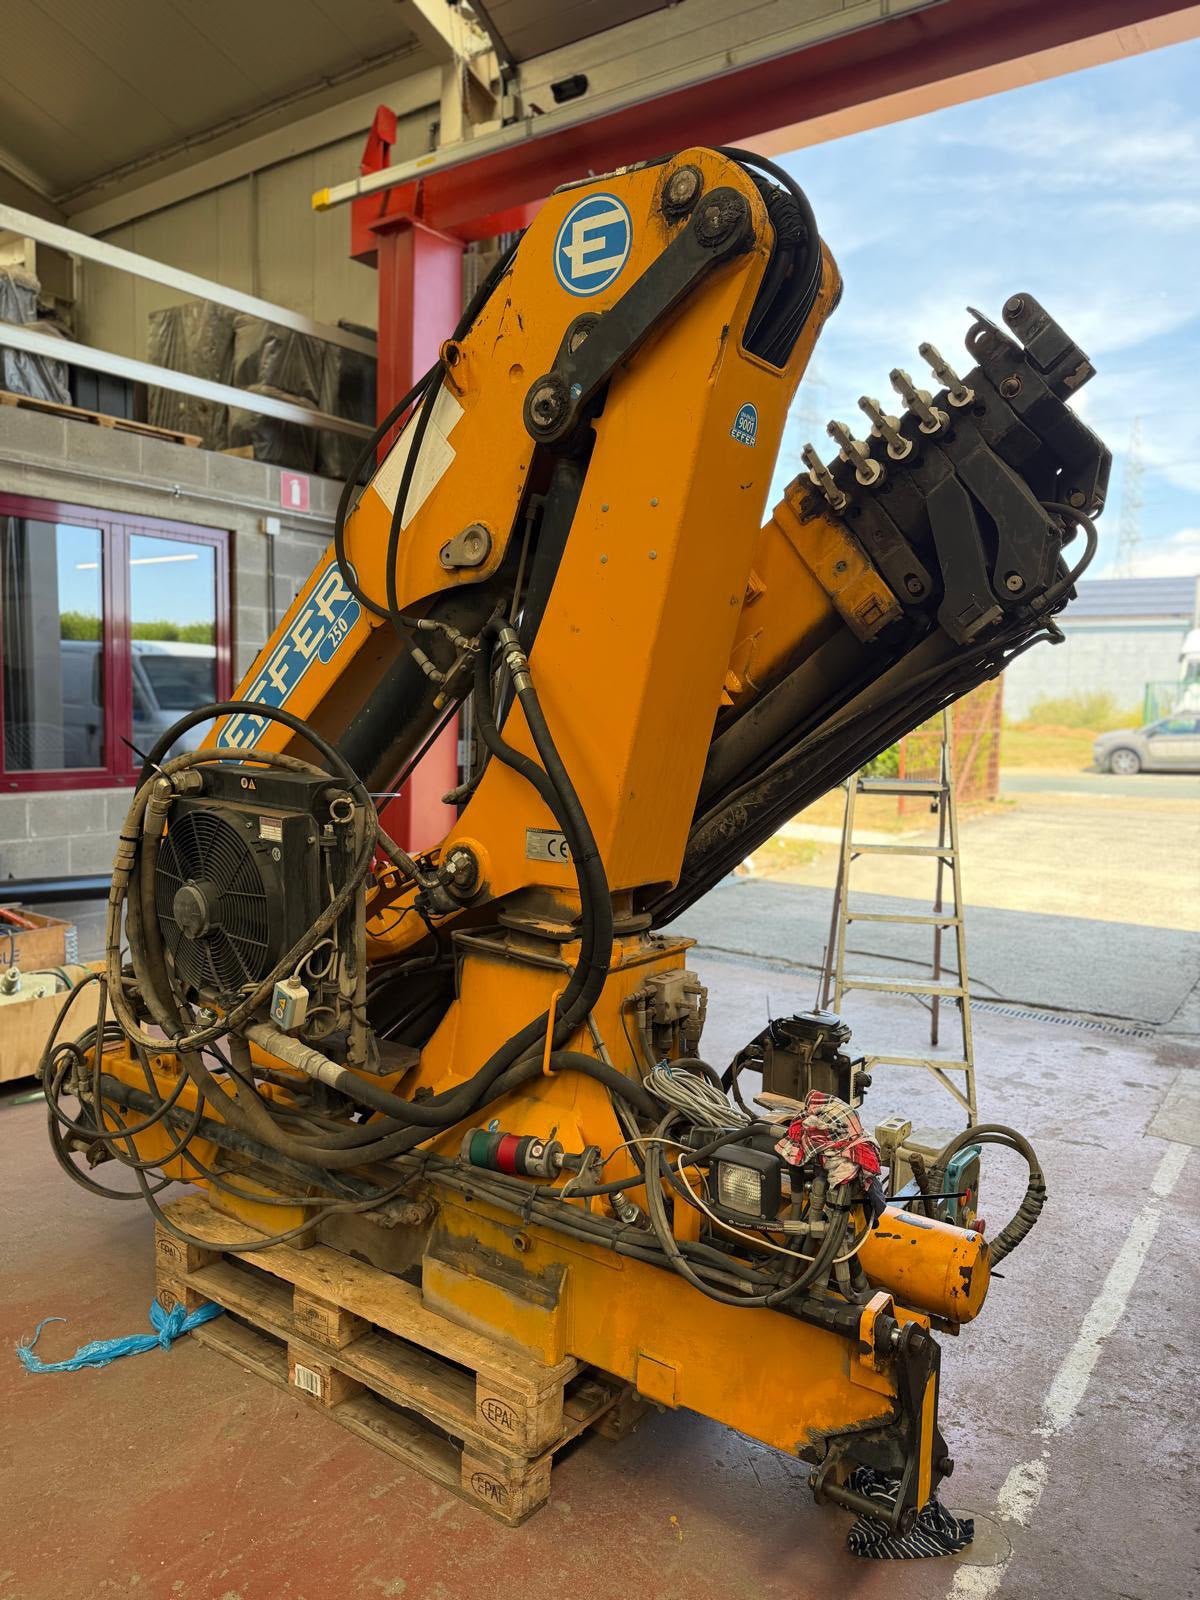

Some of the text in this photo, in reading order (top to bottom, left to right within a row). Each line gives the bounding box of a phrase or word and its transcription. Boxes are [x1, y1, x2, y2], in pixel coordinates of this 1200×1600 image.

[562, 208, 628, 279] E
[731, 429, 756, 447] EFFER
[738, 417, 755, 434] 9001
[328, 617, 348, 648] 250
[548, 838, 569, 858] CE
[486, 1402, 515, 1432] EPAL
